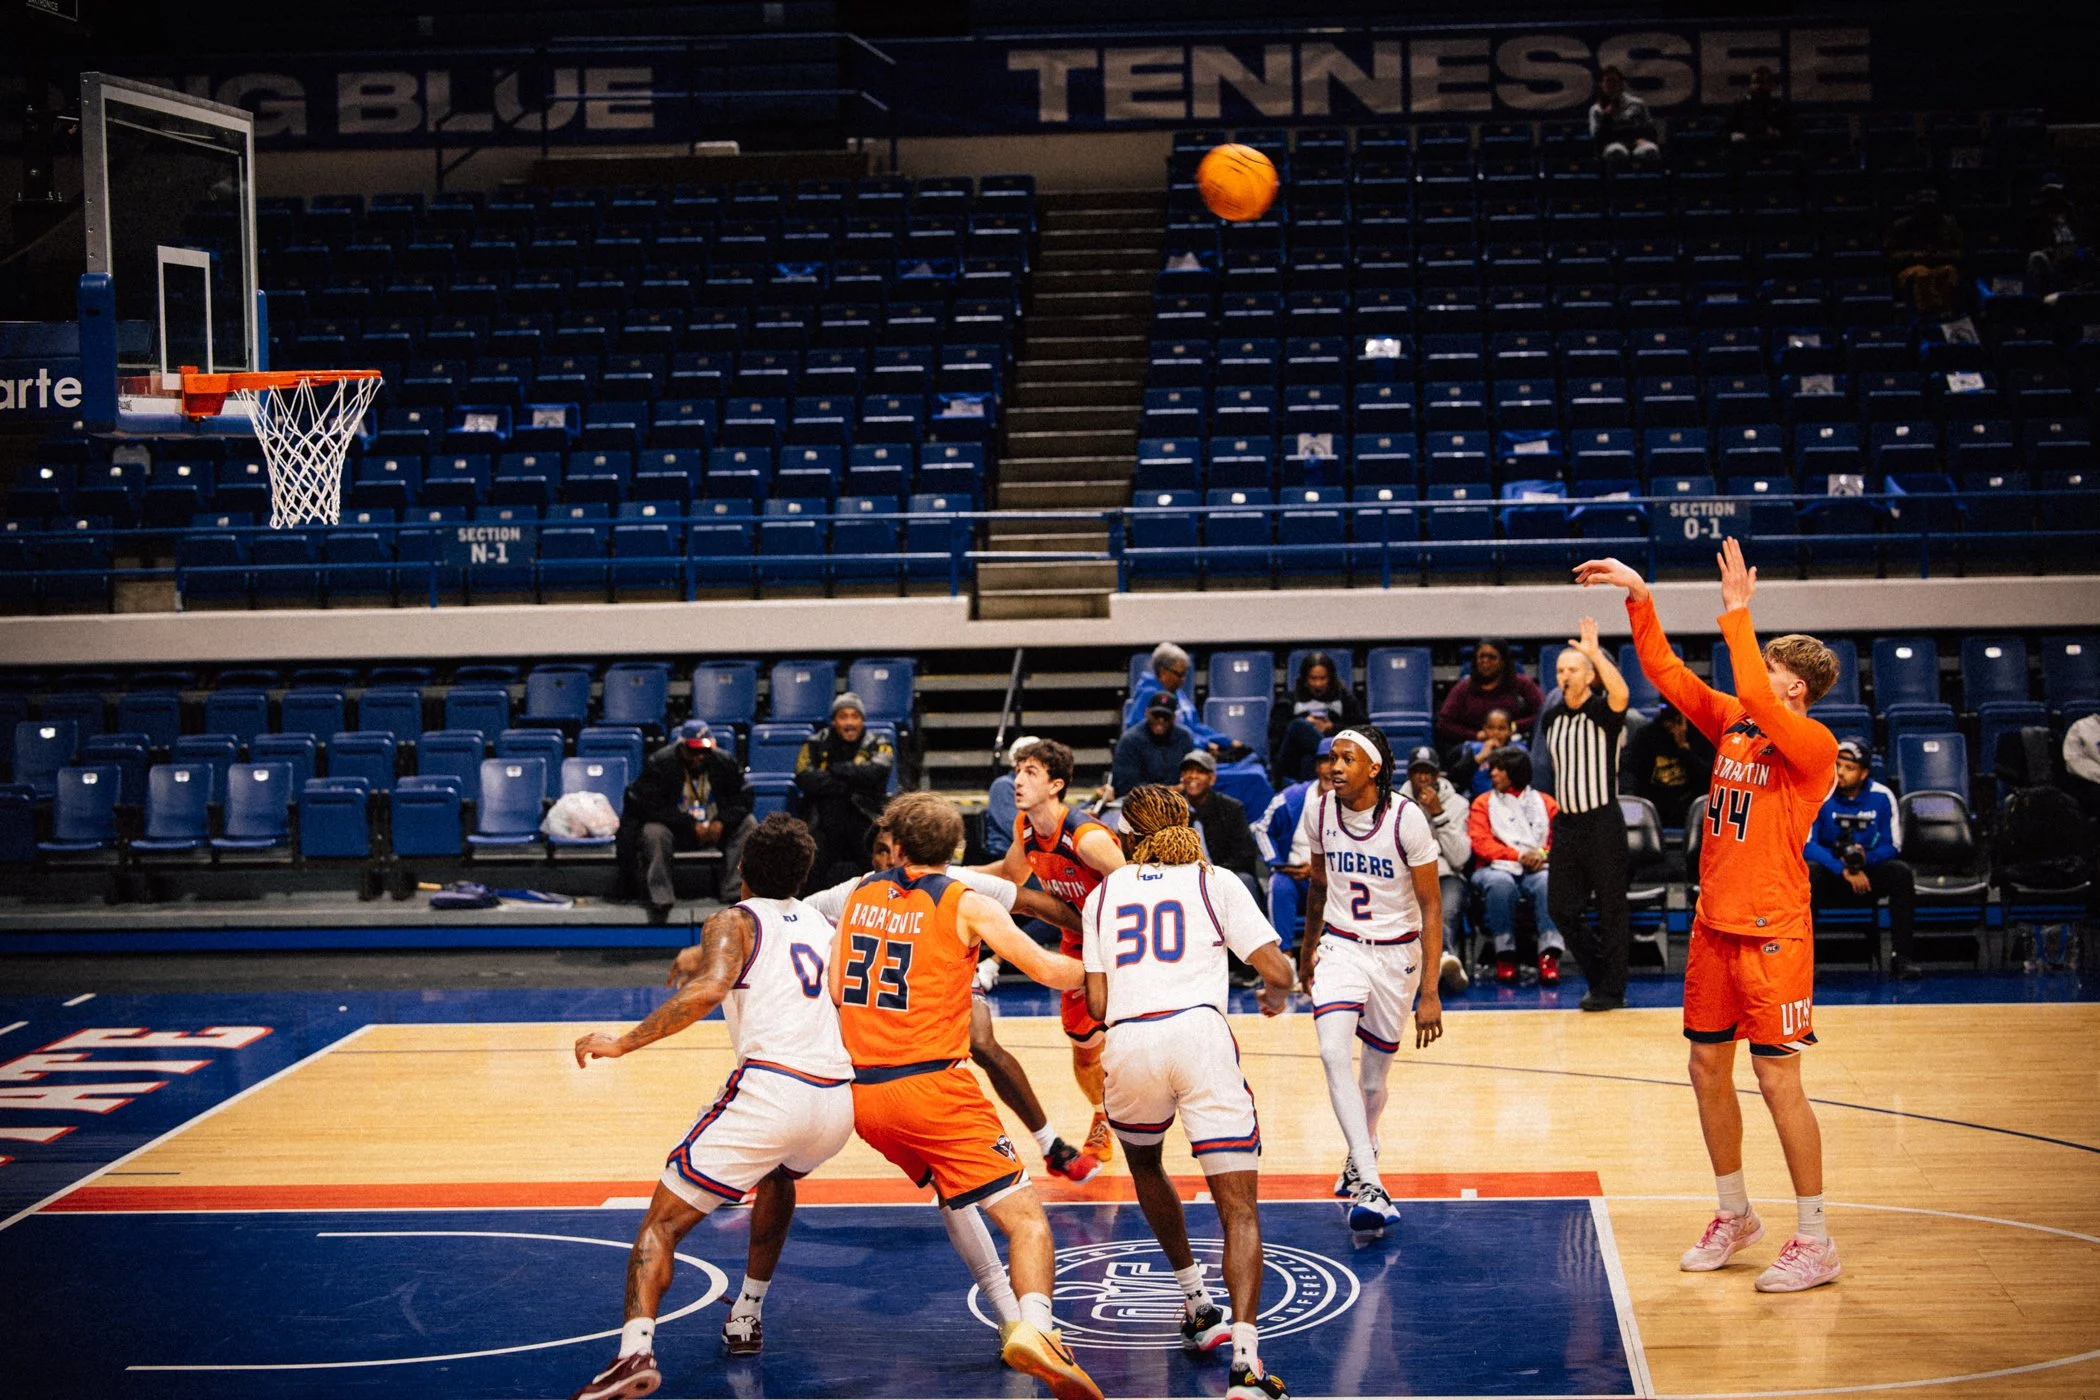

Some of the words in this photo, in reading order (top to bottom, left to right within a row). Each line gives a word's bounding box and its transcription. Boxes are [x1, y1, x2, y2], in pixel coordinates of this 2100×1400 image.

[337, 66, 655, 135] BLUE
[1007, 28, 1873, 124] TENNESSEE
[457, 526, 520, 542] SECTION
[1669, 502, 1736, 518] SECTION
[470, 542, 509, 564] N-1
[1706, 784, 1753, 842] 44
[1326, 851, 1394, 879] TIGERS
[1349, 881, 1373, 921] 2
[1115, 899, 1186, 969] 30
[790, 942, 824, 999] 0
[842, 932, 914, 1012] 33
[0, 1026, 274, 1168] ATE
[1257, 1253, 1321, 1329] ONFERENCE
